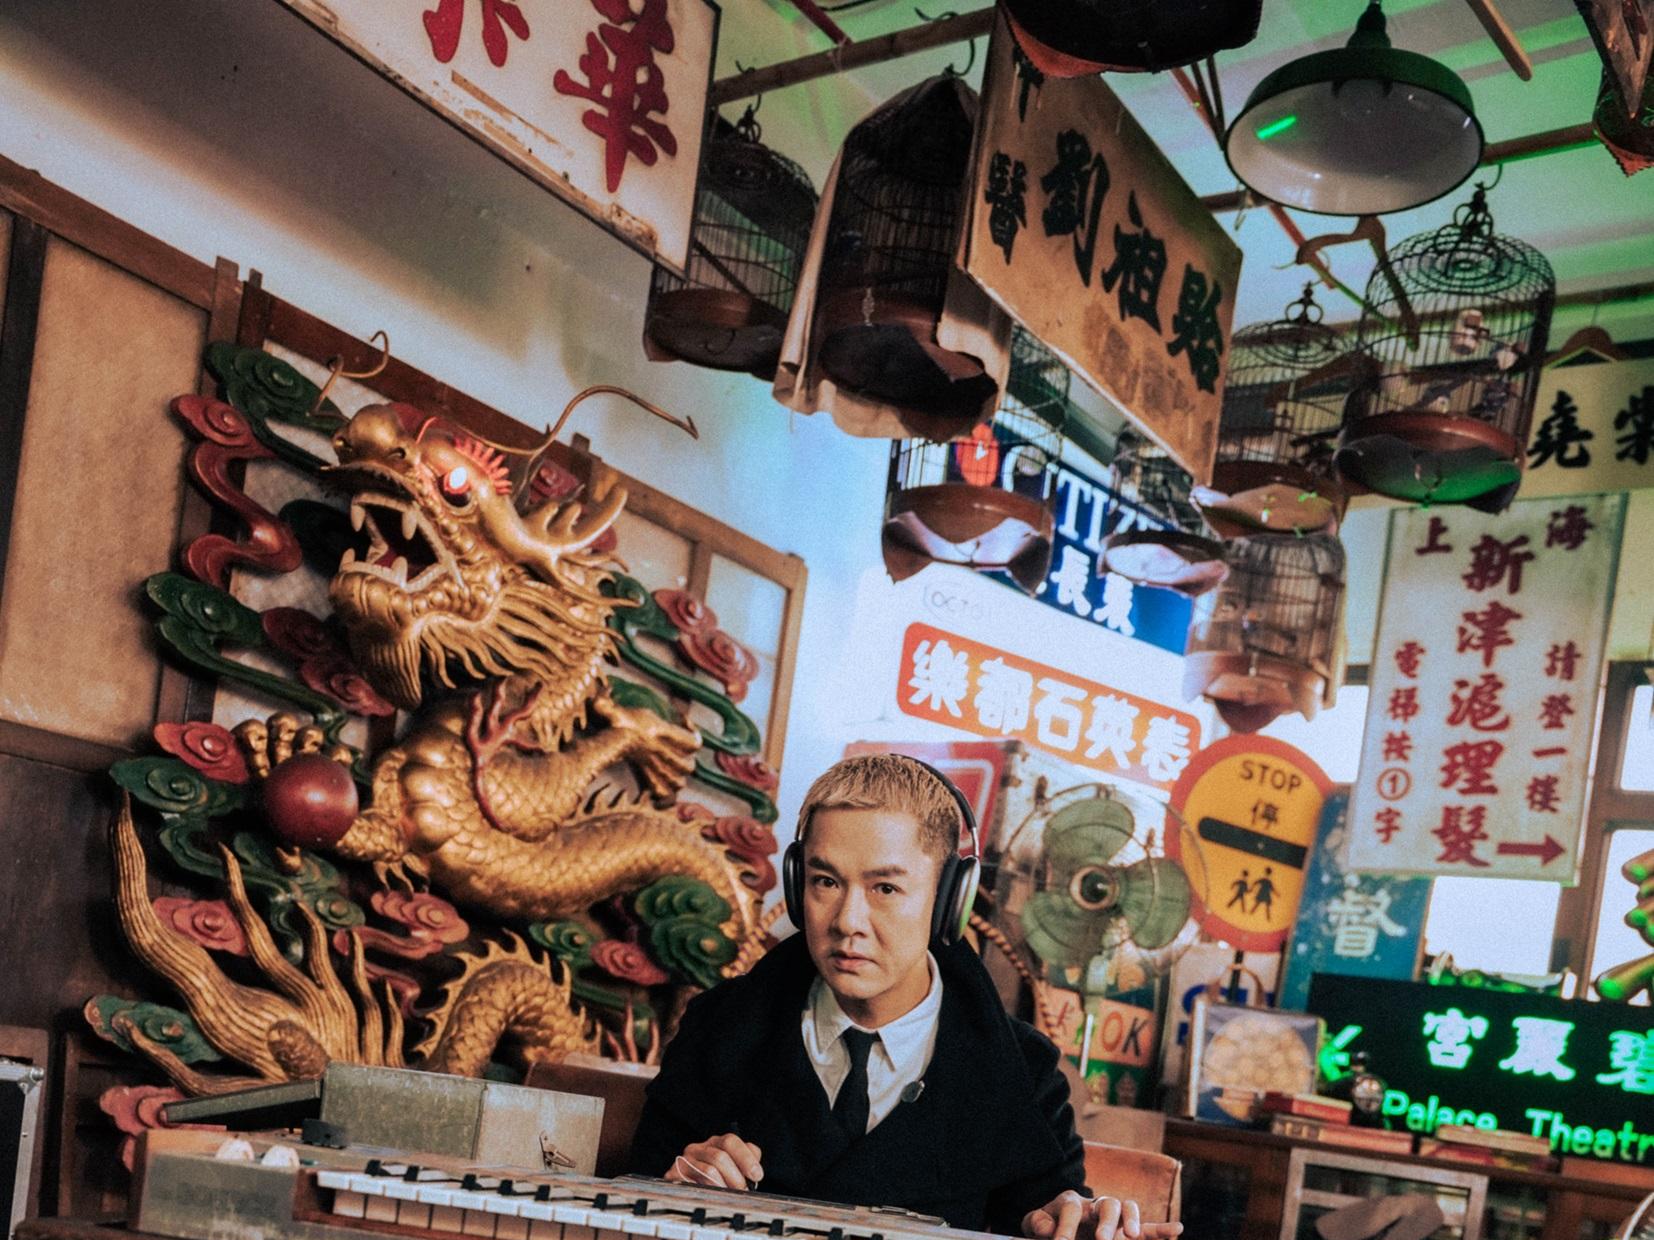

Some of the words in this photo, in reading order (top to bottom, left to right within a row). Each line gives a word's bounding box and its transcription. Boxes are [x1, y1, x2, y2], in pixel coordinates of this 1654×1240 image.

[909, 640, 1191, 782] 樂都石英表
[1431, 533, 1535, 868] 新津滬理髮
[1526, 641, 1582, 813] 請登一樓
[1239, 760, 1302, 794] STOP
[1251, 799, 1279, 829] 停
[1326, 873, 1407, 957] 督
[1382, 1089, 1498, 1132] Palace
